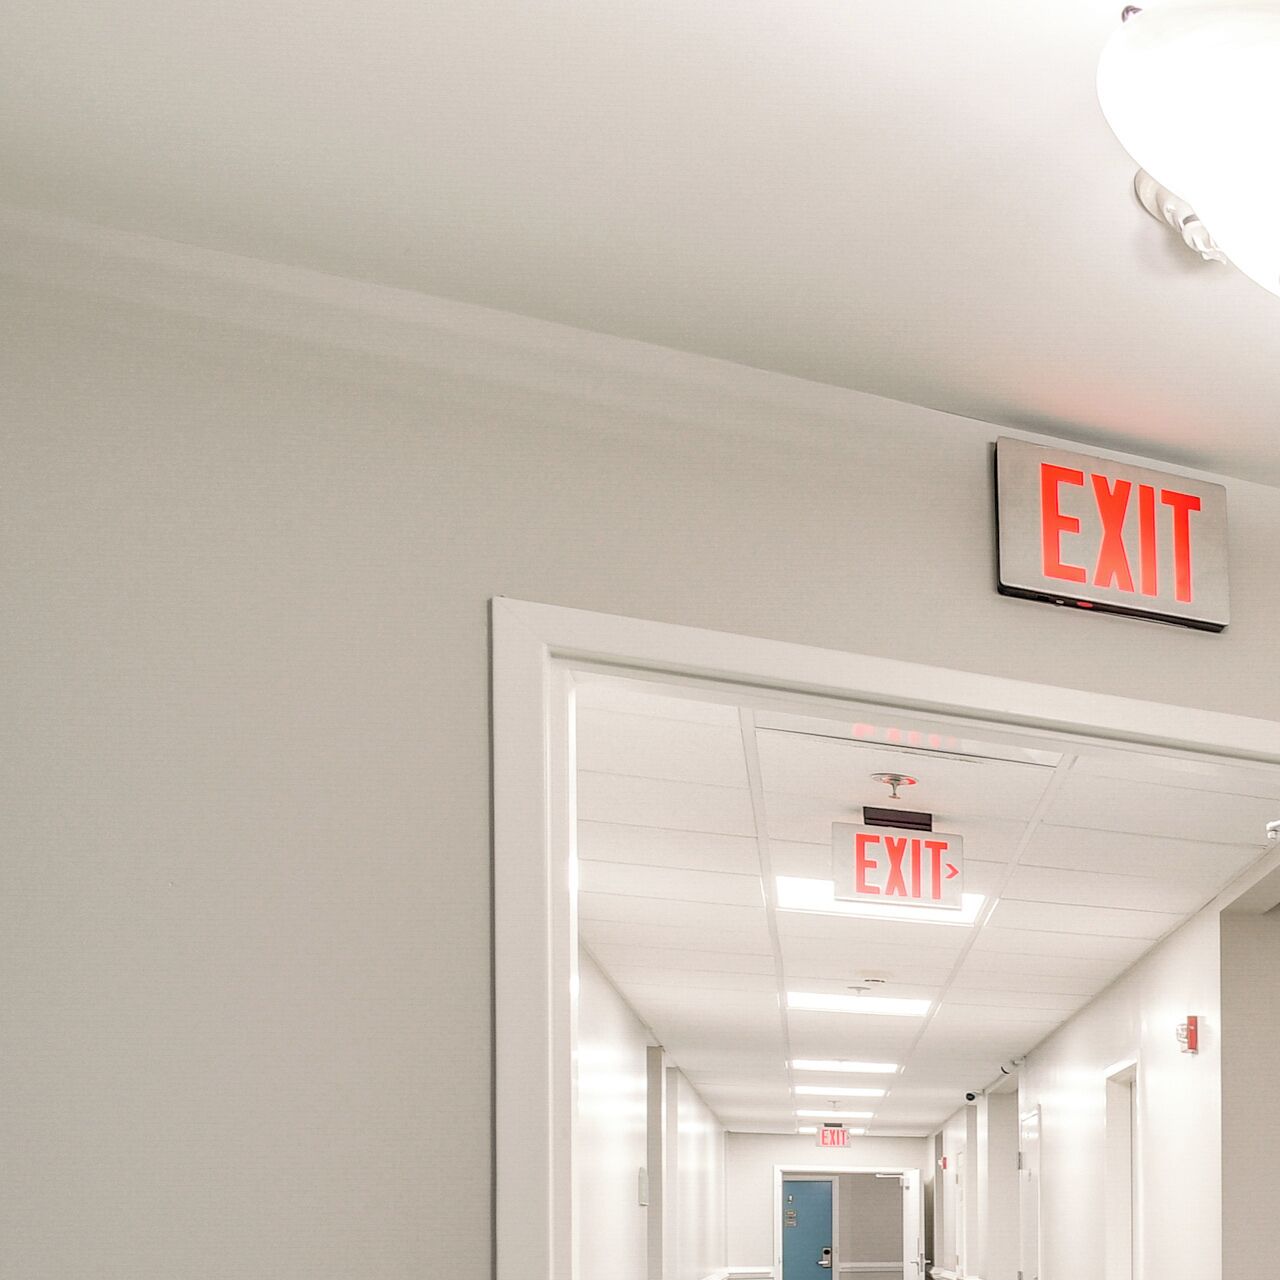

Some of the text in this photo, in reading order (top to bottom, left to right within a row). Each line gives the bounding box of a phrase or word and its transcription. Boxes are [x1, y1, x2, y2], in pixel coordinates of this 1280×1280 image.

[1040, 462, 1201, 603] EXIT
[855, 833, 948, 900] EXIT
[821, 1129, 847, 1146] EXIT
